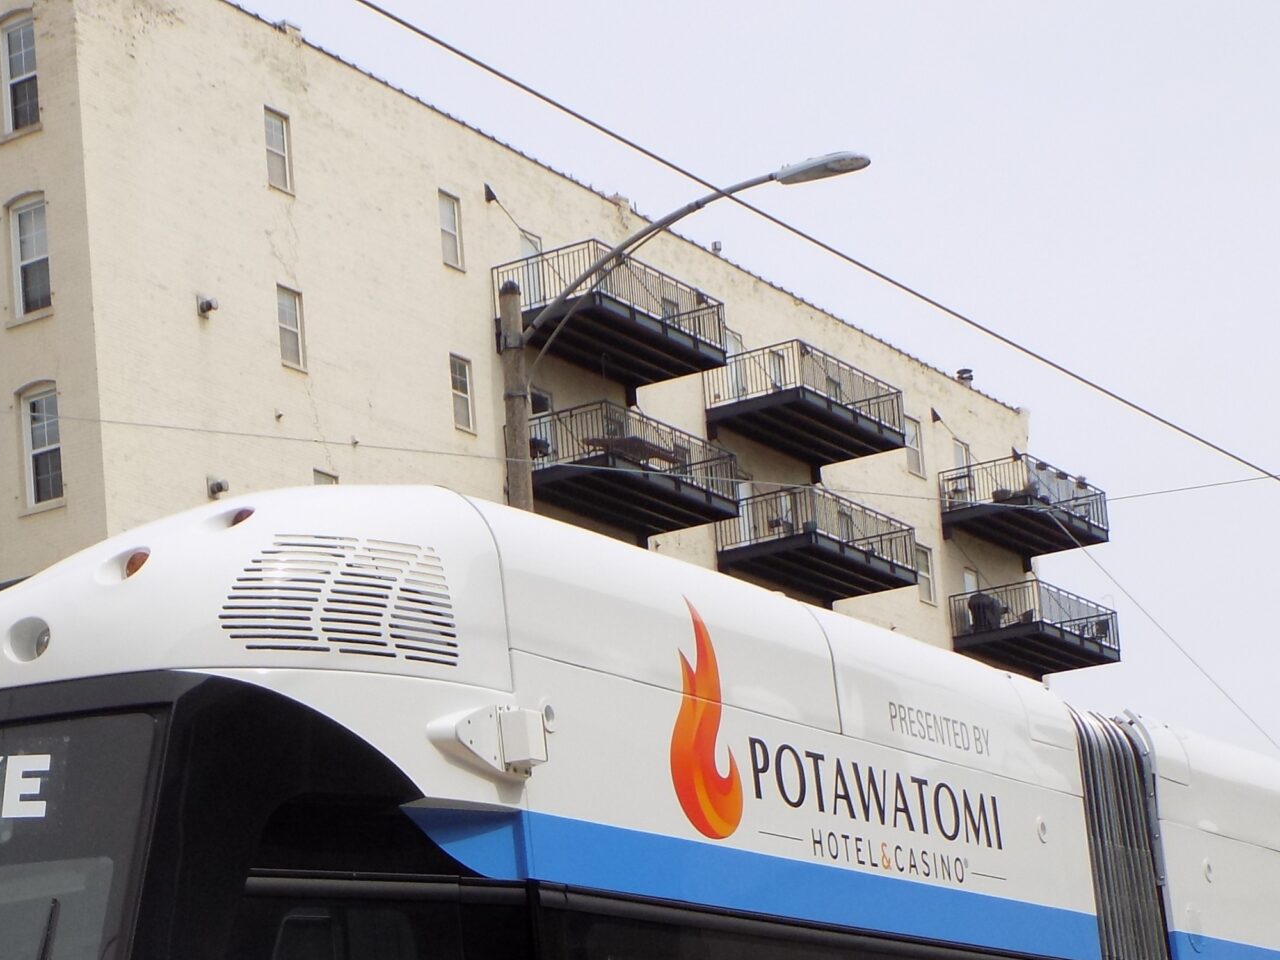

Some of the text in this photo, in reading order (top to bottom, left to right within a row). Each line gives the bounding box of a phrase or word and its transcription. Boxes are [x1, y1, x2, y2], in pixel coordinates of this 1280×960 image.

[888, 701, 992, 757] PRESENTED BY
[748, 736, 1004, 851] POTAWATOMI
